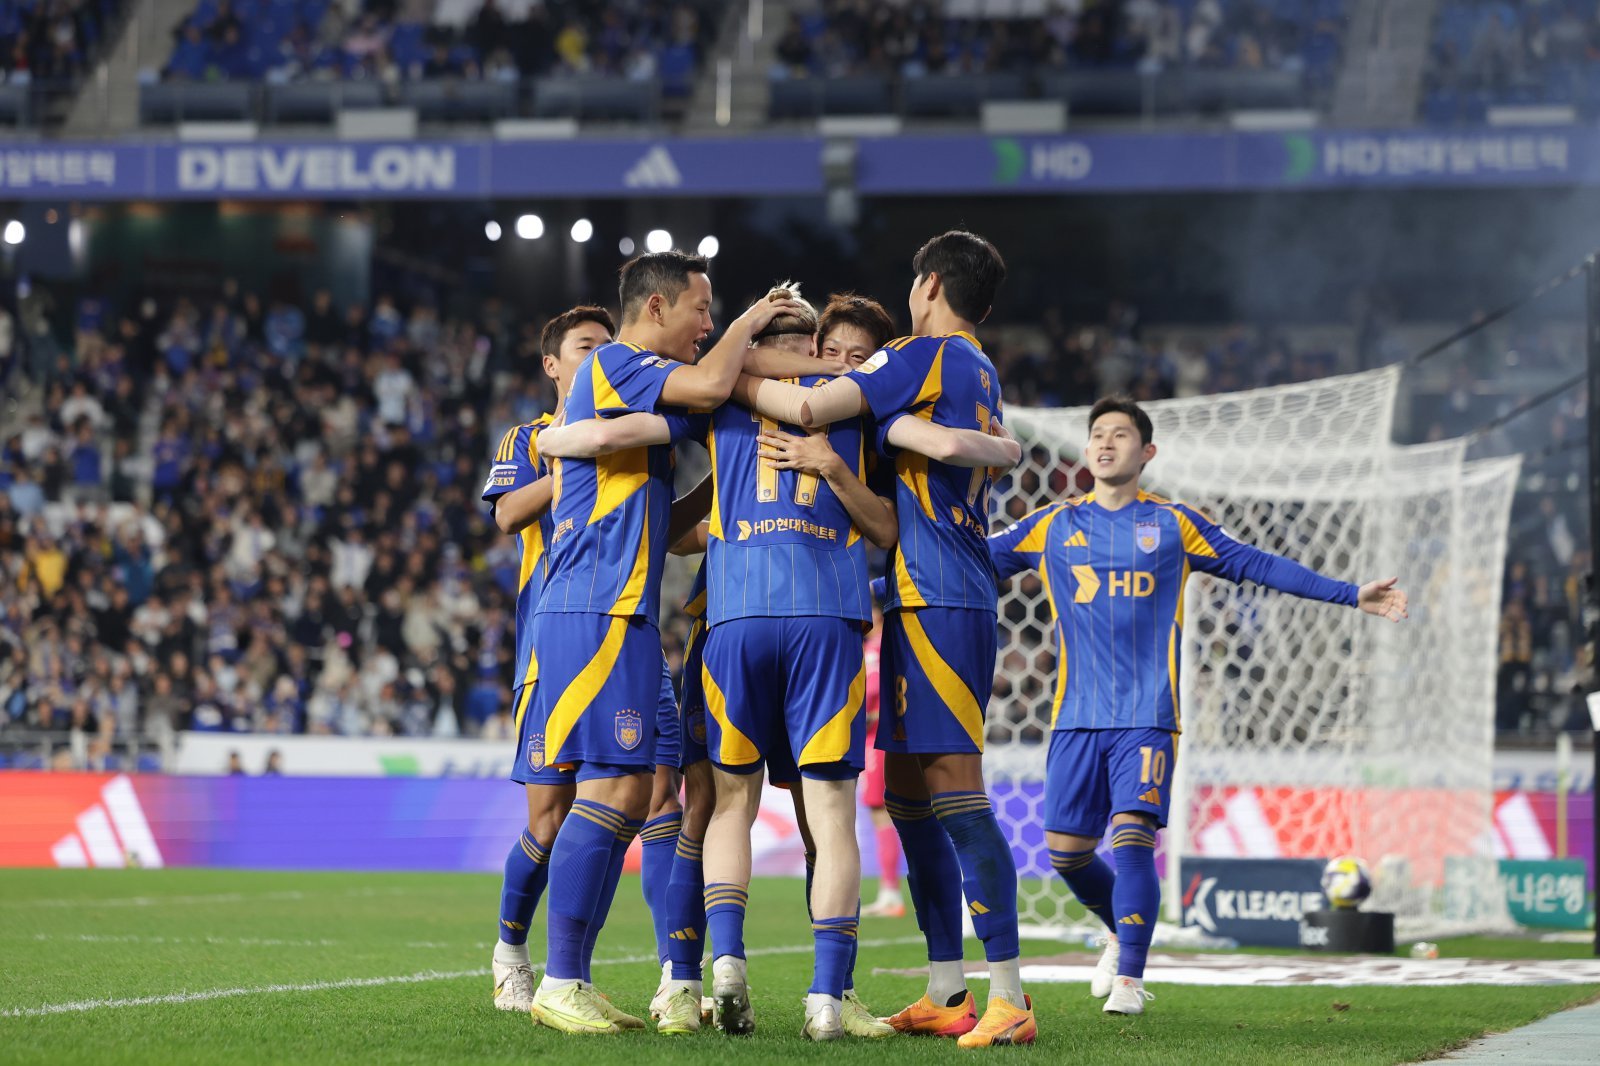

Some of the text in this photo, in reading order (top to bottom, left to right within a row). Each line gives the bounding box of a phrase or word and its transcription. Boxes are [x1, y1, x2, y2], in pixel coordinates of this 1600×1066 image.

[0, 150, 116, 187] 일렉트릭
[178, 148, 456, 191] DEVELON
[1031, 143, 1092, 180] HD
[1108, 570, 1156, 597] HD
[1139, 746, 1166, 787] 10
[1236, 890, 1324, 921] LEAGUE
